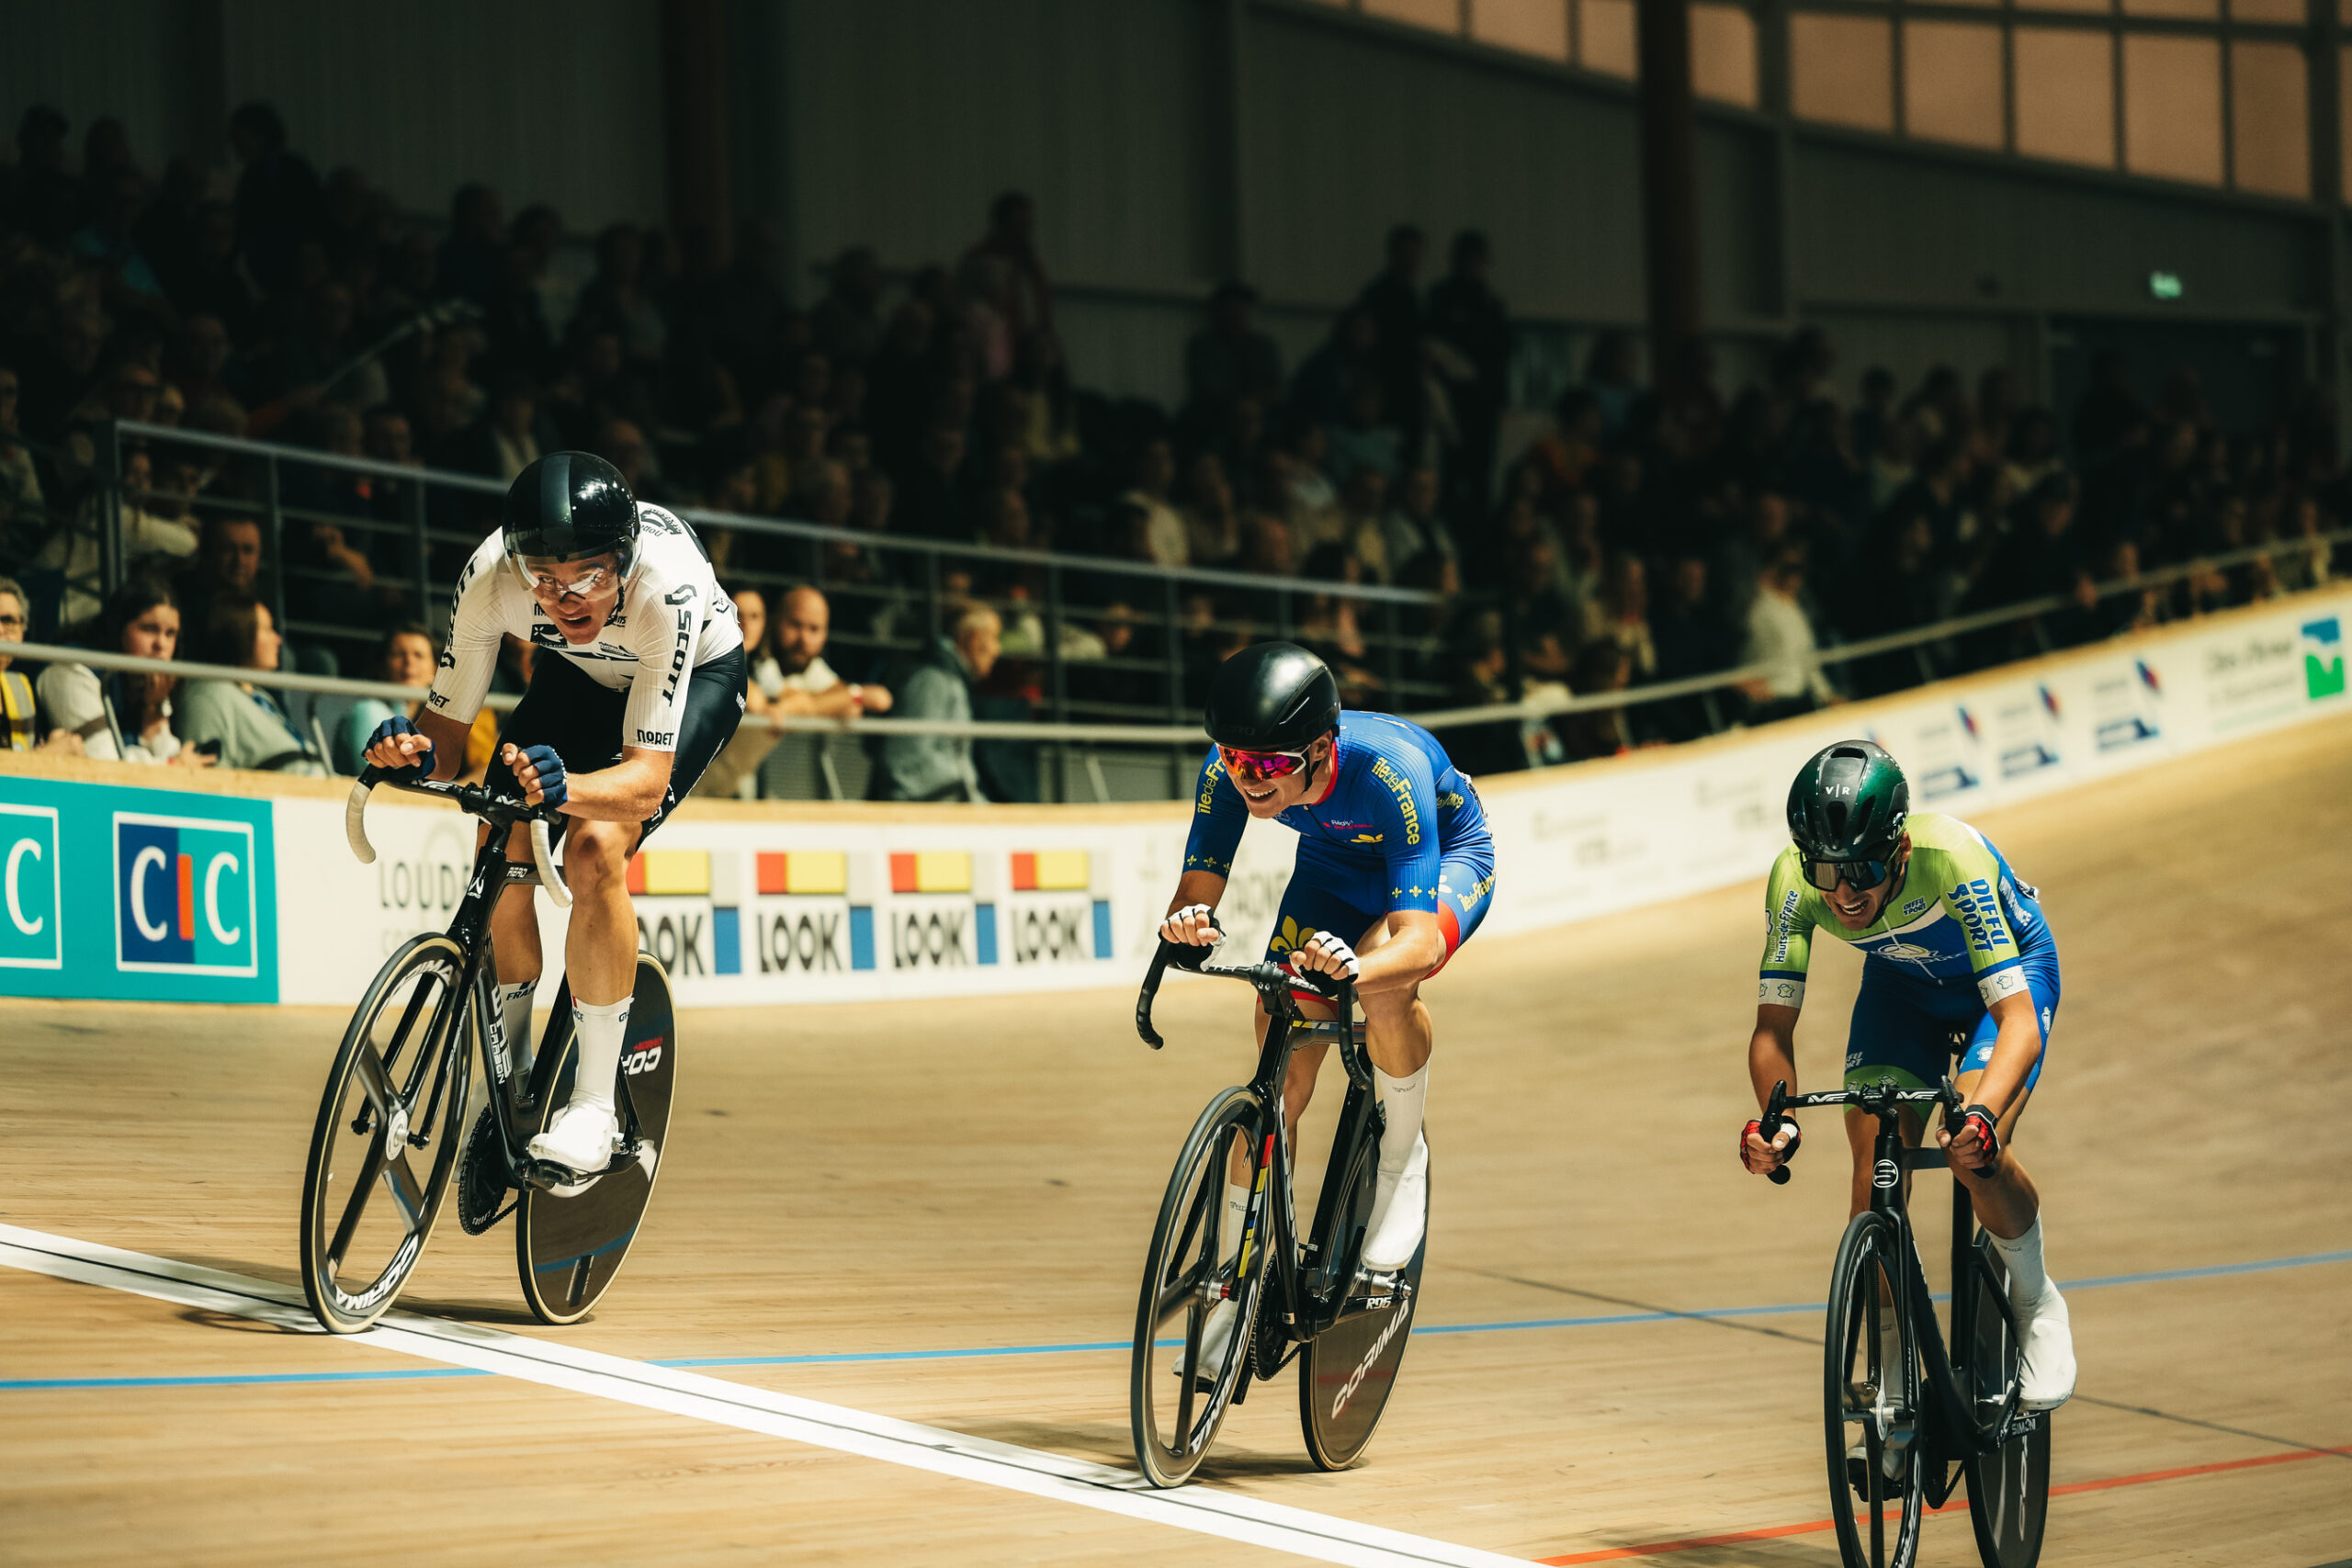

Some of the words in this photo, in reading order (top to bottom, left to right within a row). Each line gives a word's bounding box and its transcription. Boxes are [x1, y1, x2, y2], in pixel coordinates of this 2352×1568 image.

[662, 609, 692, 707] SCOTT
[130, 845, 241, 945] CIC
[506, 866, 528, 878] AERO
[1903, 897, 1925, 910] DIFFU
[1903, 903, 1927, 916] SPORT
[1947, 884, 1994, 952] SPORT
[1970, 879, 2010, 945] DIFFU
[758, 914, 842, 973] LOOK
[891, 909, 968, 968] LOOK
[1012, 907, 1085, 964] LOOK
[490, 1023, 505, 1085] CARBON
[1332, 1298, 1409, 1419] CORIMA
